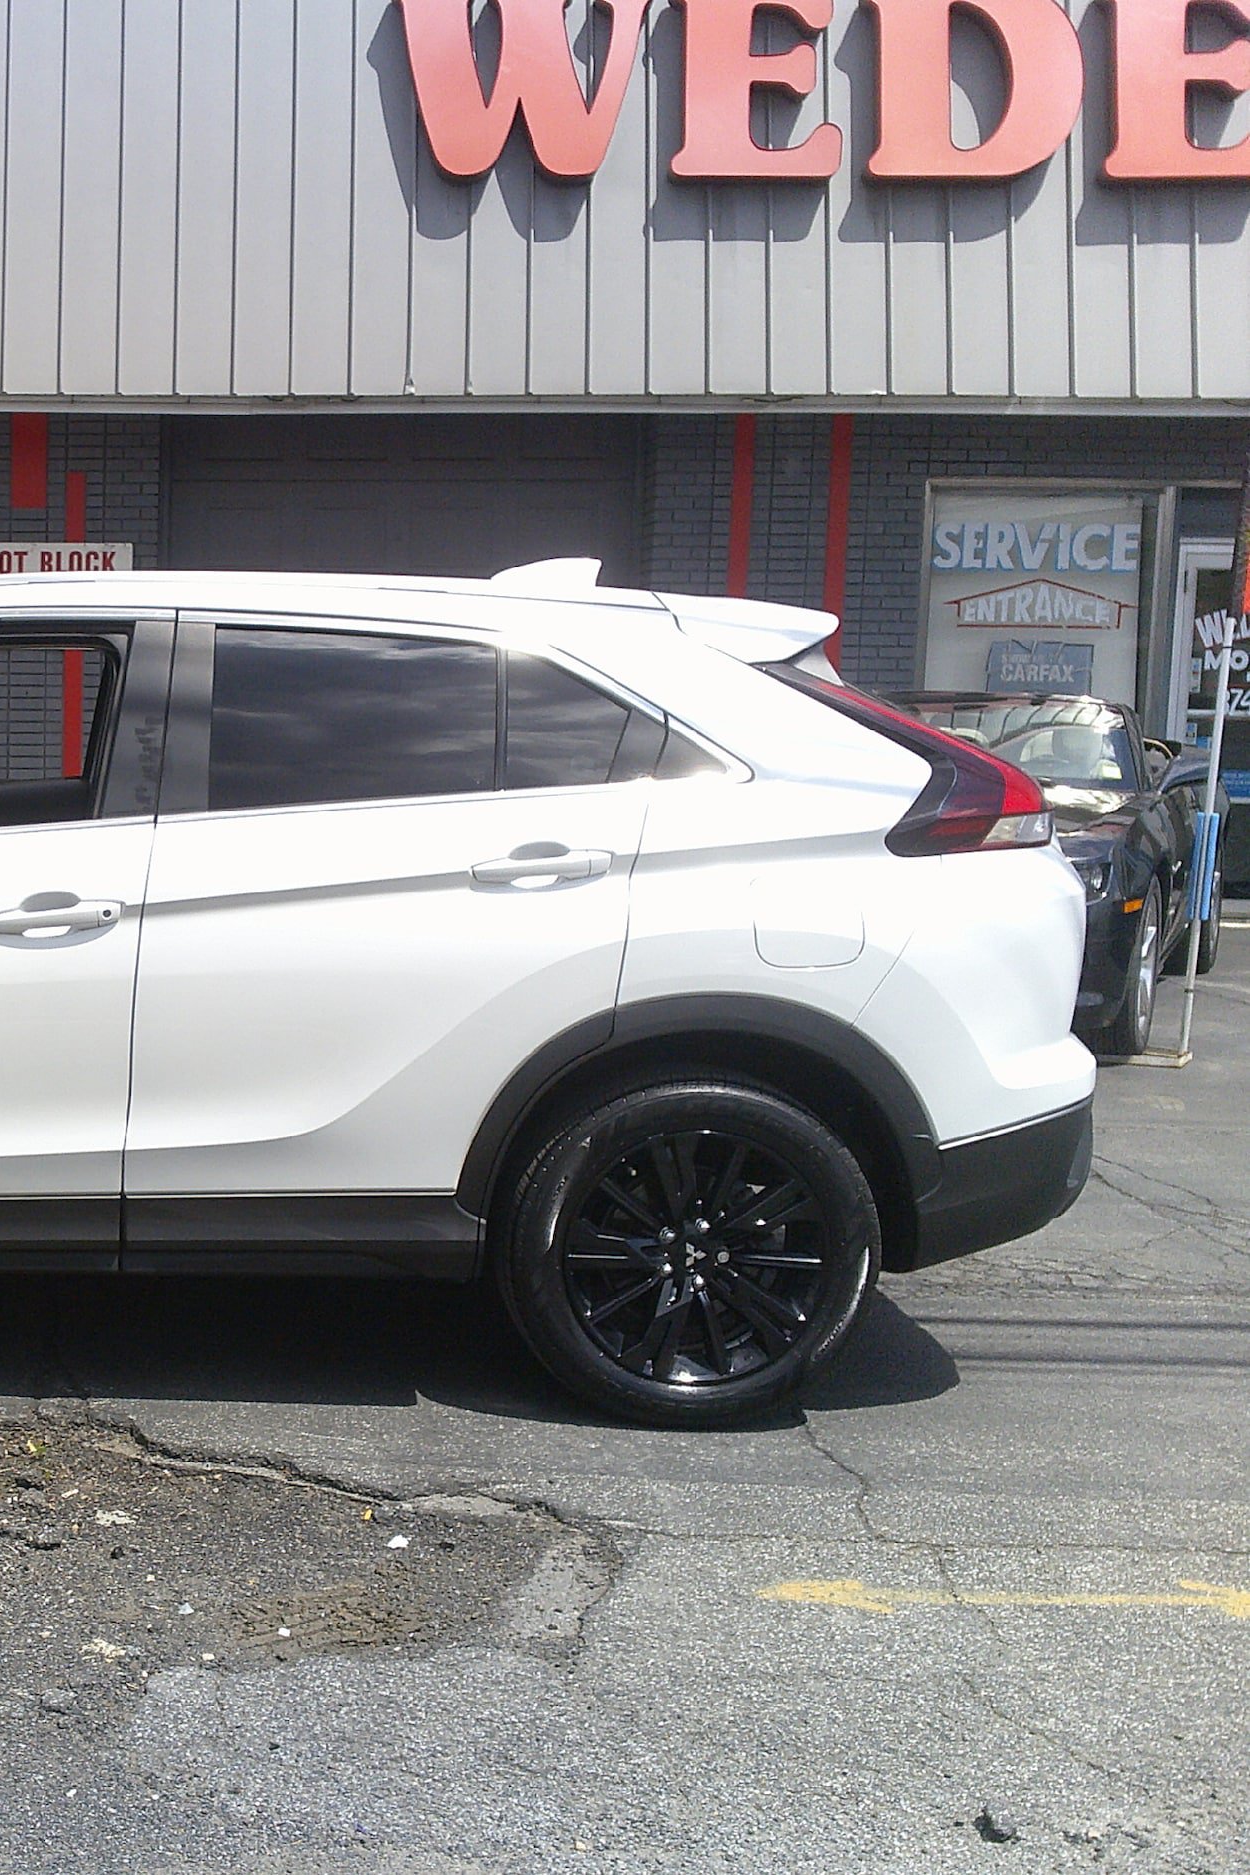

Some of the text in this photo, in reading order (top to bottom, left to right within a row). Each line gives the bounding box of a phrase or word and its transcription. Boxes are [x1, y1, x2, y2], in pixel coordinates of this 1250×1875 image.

[398, 0, 1250, 180] WEDE
[40, 551, 117, 572] BLOCK
[932, 522, 1141, 572] SERVICE
[963, 584, 1111, 624] ENTRANCE
[1000, 663, 1074, 683] CARFAX
